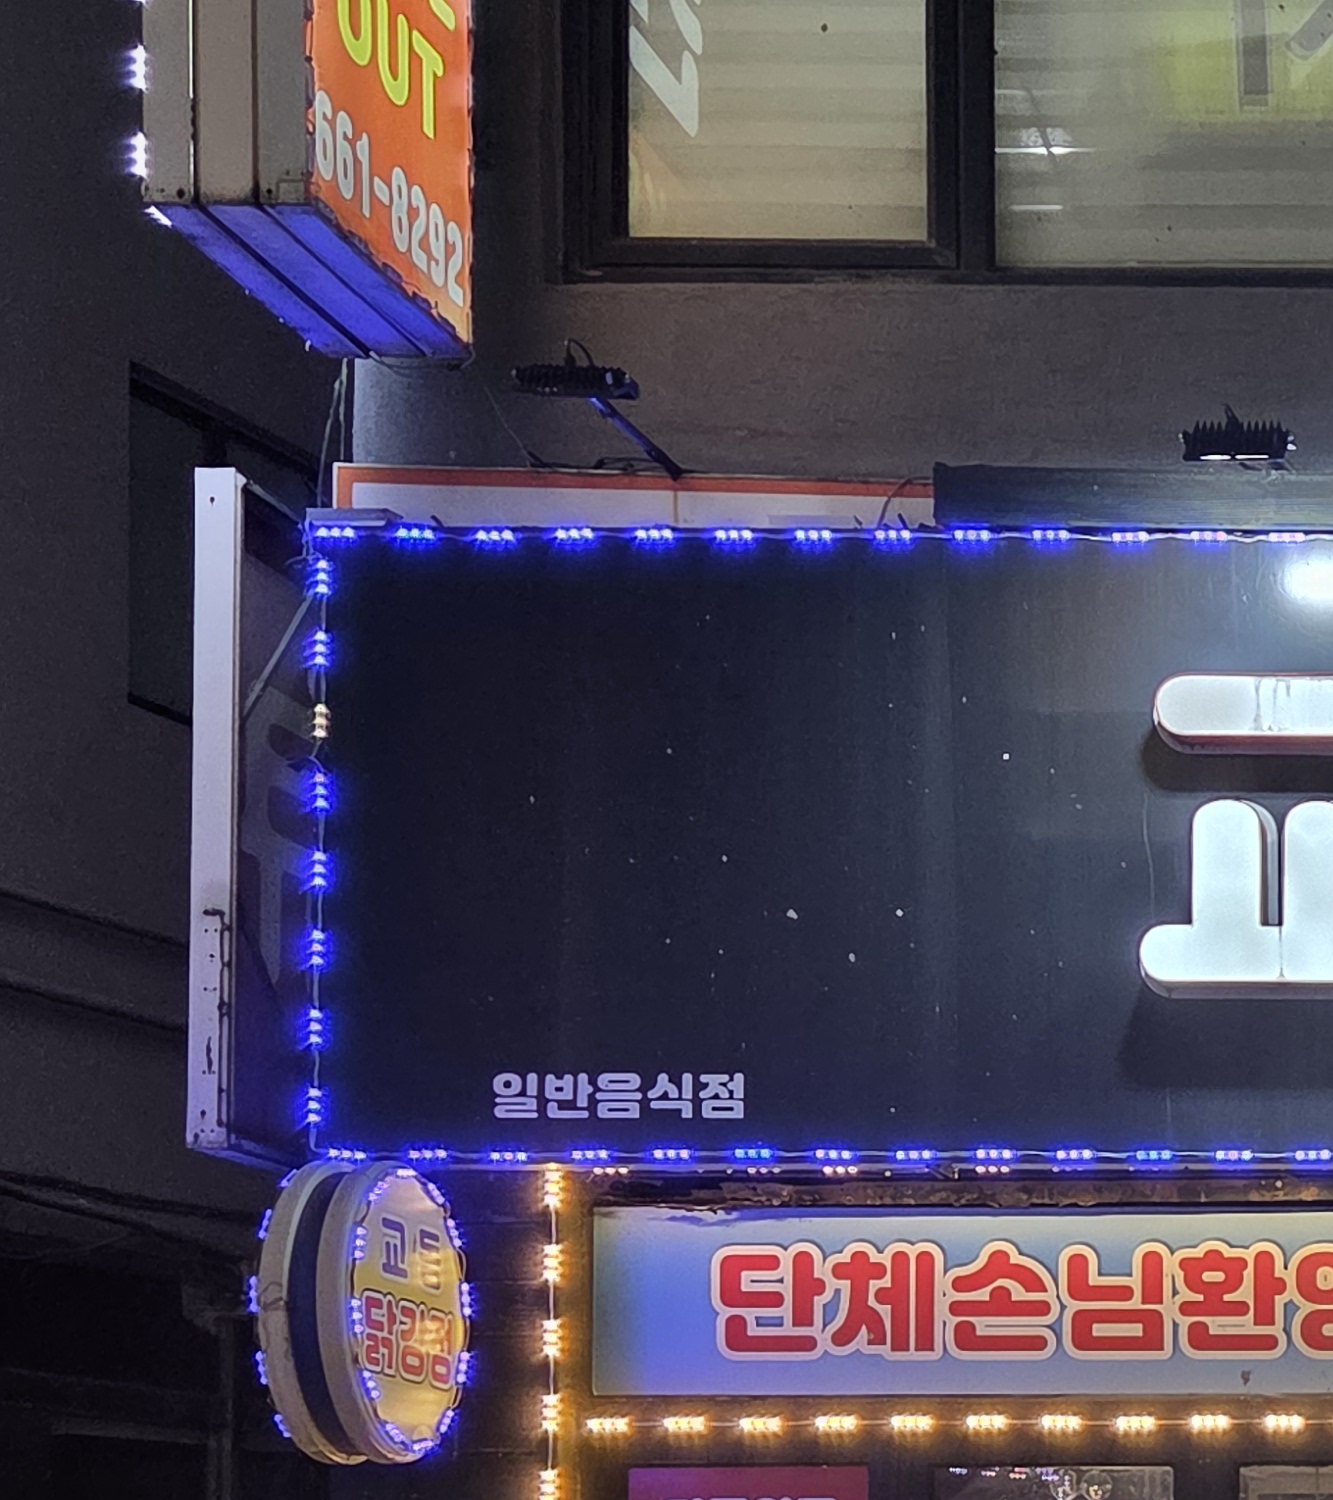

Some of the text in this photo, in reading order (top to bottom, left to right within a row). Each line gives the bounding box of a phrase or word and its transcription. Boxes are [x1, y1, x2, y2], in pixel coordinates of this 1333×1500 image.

[315, 89, 464, 307] 661-8292
[492, 1072, 745, 1119] 일반음식점
[358, 1290, 454, 1390] 닭강정
